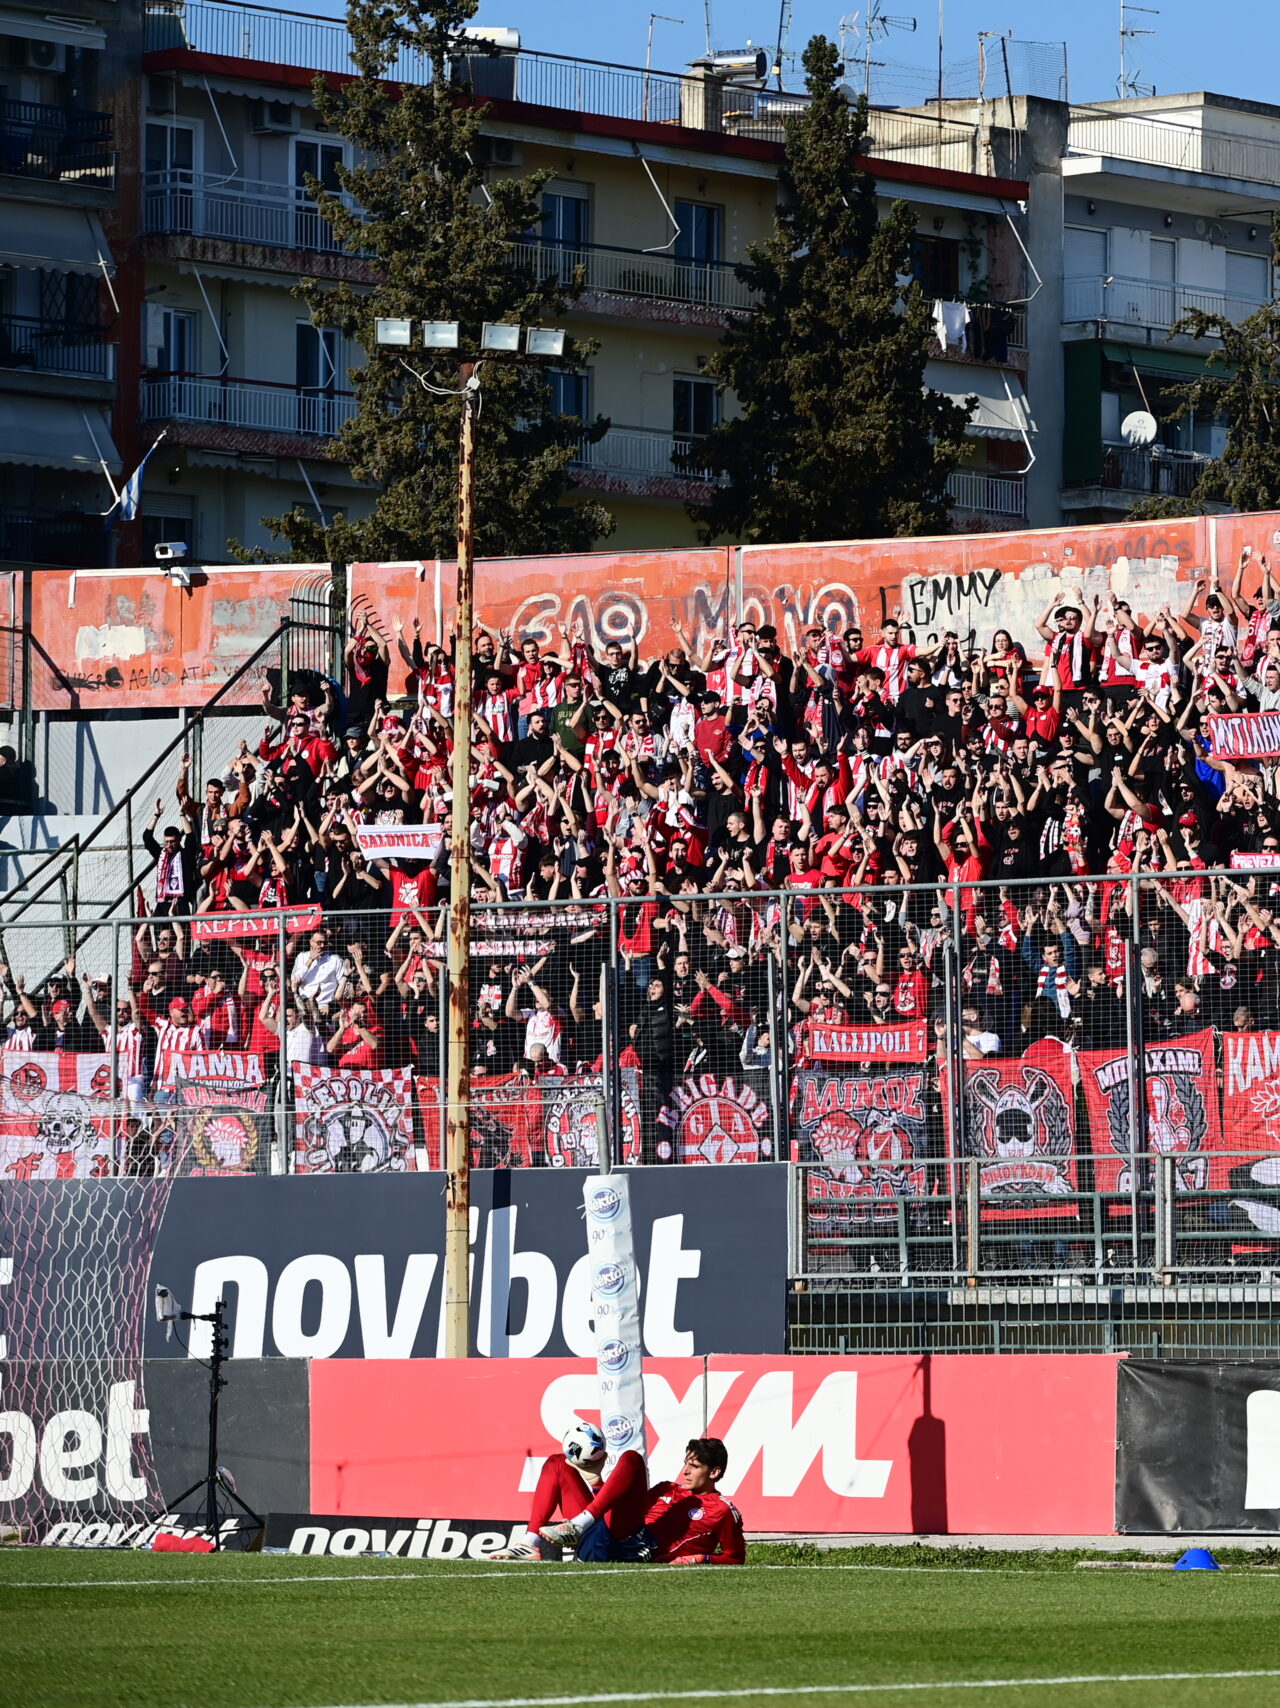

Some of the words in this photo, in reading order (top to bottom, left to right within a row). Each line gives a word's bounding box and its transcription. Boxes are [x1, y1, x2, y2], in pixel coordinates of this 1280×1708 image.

[909, 569, 1002, 626] EMMY
[812, 1030, 911, 1054] KALLIPOLI
[1095, 1050, 1202, 1091] ΜΠΧΑΜΙ
[656, 1073, 769, 1129] BRIGADE
[41, 1513, 240, 1551] novibt
